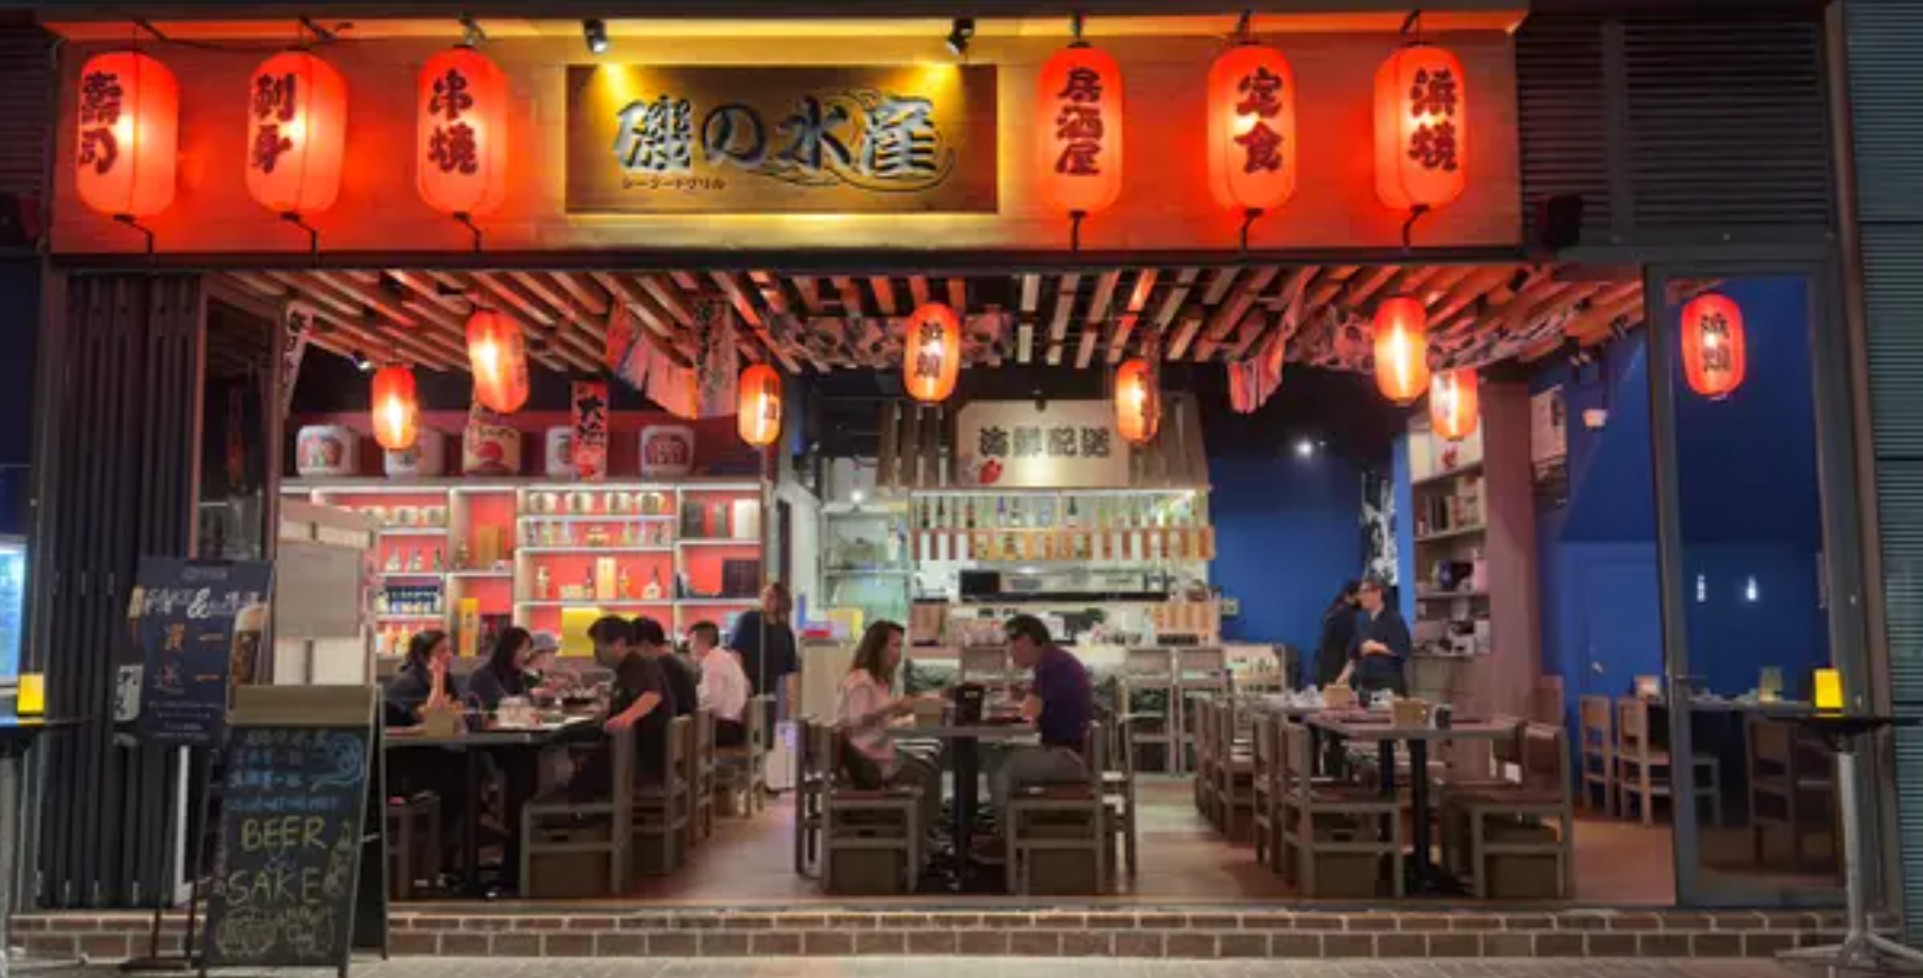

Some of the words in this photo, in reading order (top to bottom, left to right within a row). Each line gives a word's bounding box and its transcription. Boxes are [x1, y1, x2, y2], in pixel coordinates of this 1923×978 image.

[250, 73, 296, 174] 刺身
[1055, 67, 1103, 175] 居酒屋
[1235, 67, 1283, 173] 定食
[241, 816, 326, 849] BEER
[226, 866, 322, 905] SAKE
